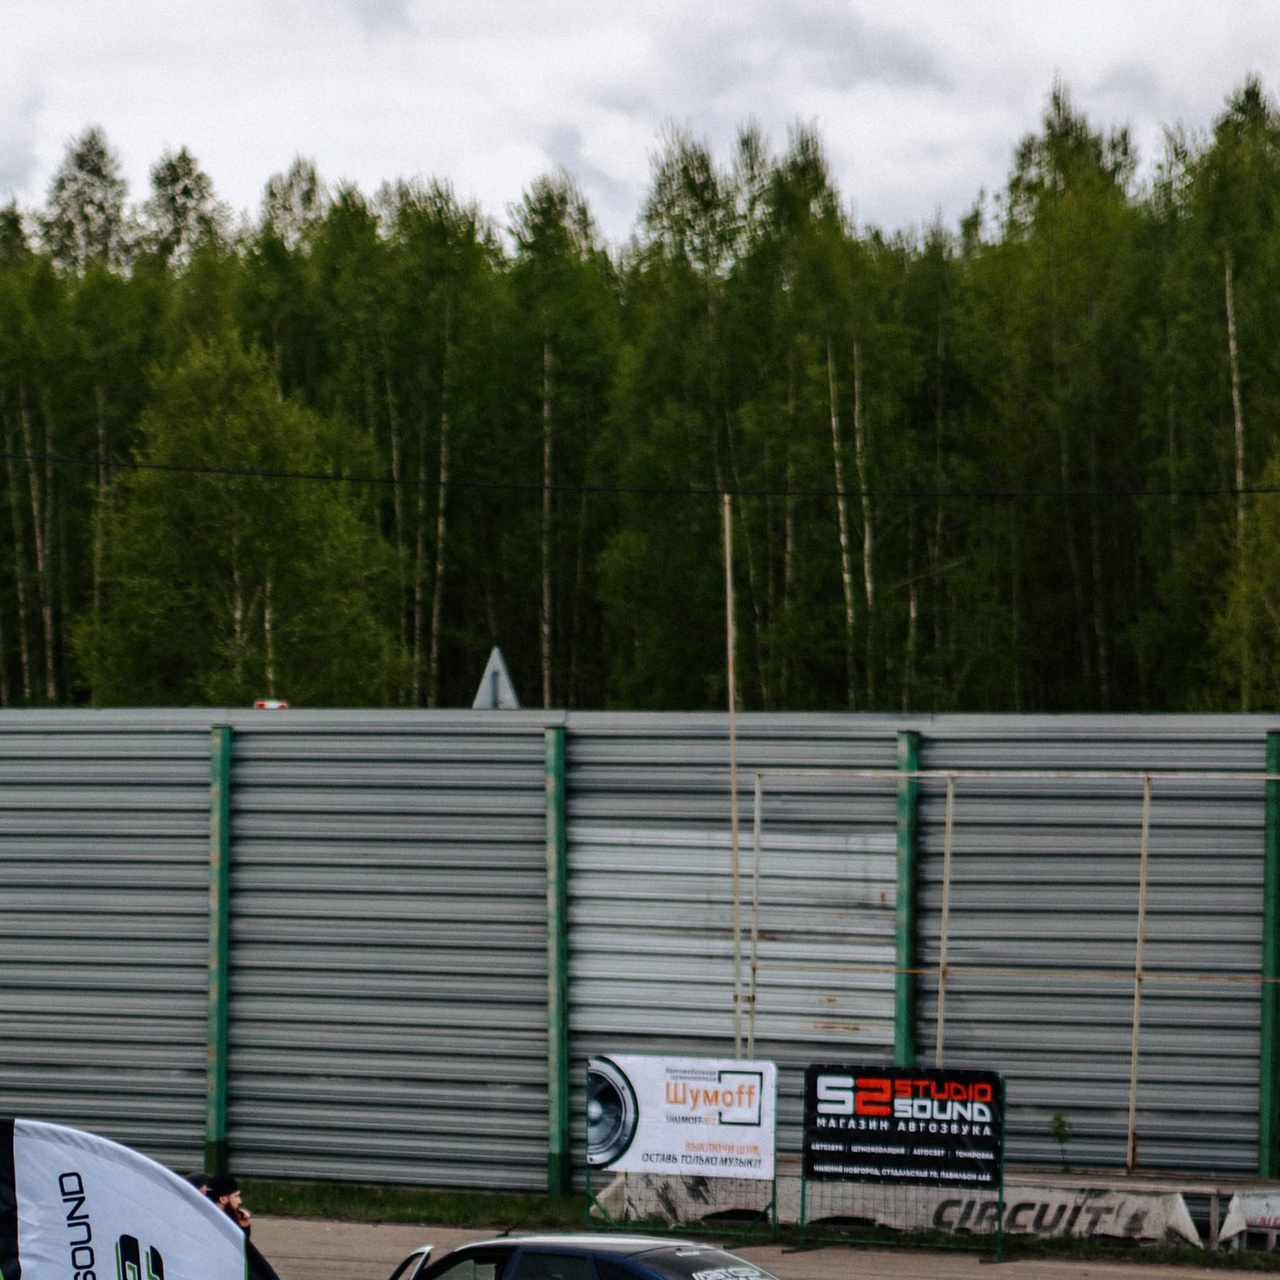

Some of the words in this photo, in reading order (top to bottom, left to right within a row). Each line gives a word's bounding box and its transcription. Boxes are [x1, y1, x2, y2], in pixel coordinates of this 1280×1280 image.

[894, 1079, 992, 1102] STUDIO
[894, 1098, 992, 1122] SOUND
[817, 1118, 889, 1131] МАГАЗИН
[897, 1122, 992, 1136] АВТОЗВУКА
[641, 1153, 678, 1164] ОСТАВЬ
[681, 1154, 718, 1166] ТОЛЬКО
